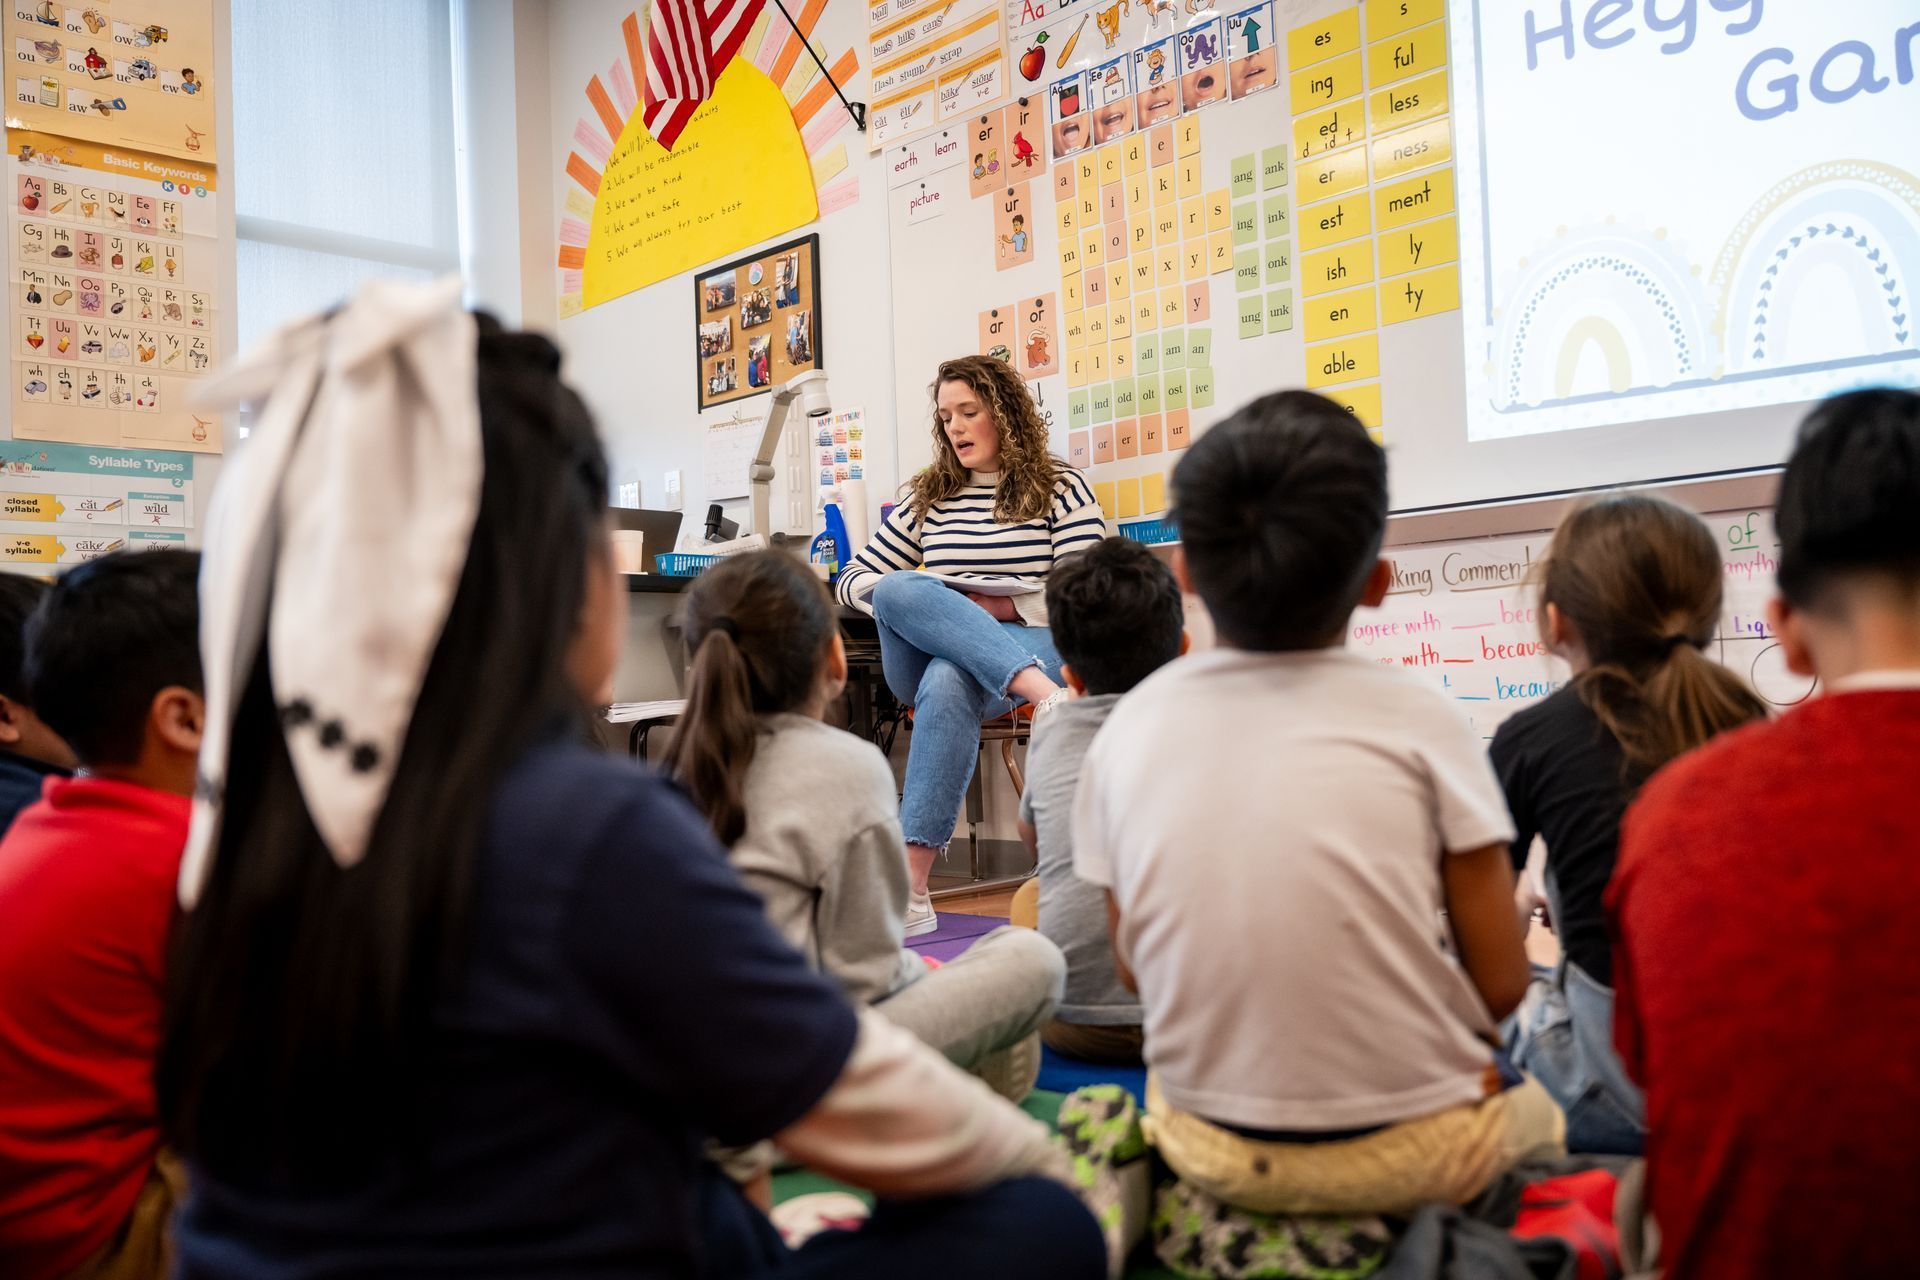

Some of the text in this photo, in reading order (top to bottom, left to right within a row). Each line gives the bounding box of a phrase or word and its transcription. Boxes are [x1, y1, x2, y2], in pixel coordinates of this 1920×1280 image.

[1021, 0, 1045, 26] Aa
[1400, 2, 1408, 15] s
[17, 10, 33, 21] oa
[67, 23, 82, 33] oe
[922, 16, 943, 32] cans
[1229, 18, 1242, 30] Uu
[114, 35, 133, 46] ow
[1180, 35, 1194, 46] Oo
[1314, 32, 1331, 46] es
[18, 51, 35, 62] ou
[1136, 52, 1144, 64] Ii
[1394, 42, 1414, 69] ful
[69, 63, 85, 72] oo
[874, 76, 894, 93] flash
[900, 64, 925, 80] stump
[940, 46, 963, 62] scrap
[116, 72, 131, 83] ue
[1091, 71, 1103, 82] Ee
[162, 83, 179, 93] ew
[1311, 76, 1333, 99] ing
[18, 93, 35, 103] au
[1390, 93, 1420, 114] less
[69, 103, 87, 113] aw
[693, 105, 719, 123] adults
[1019, 112, 1030, 126] ir
[1319, 112, 1338, 136] ed
[979, 127, 993, 141] er
[610, 155, 620, 170] We
[622, 141, 636, 158] will
[935, 141, 957, 157] learn
[1394, 140, 1429, 161] ness
[103, 153, 140, 171] Basic
[143, 164, 207, 183] Keywords
[614, 141, 700, 186] We will be responsible
[895, 152, 918, 172] earth
[1264, 161, 1284, 176] ank
[1234, 169, 1253, 185] ang
[1319, 170, 1335, 184] er
[24, 177, 40, 191] Aa
[53, 183, 67, 195] Bb
[81, 188, 96, 201] Cc
[108, 192, 124, 205] Dd
[615, 196, 626, 210] We
[629, 189, 642, 204] will
[647, 185, 657, 196] be
[1389, 180, 1431, 213] ment
[136, 197, 150, 210] Ee
[163, 202, 175, 214] Ff
[910, 191, 940, 215] picture
[1005, 198, 1019, 213] ur
[614, 199, 681, 234] We will be safe
[1268, 209, 1285, 224] ink
[1320, 205, 1344, 230] est
[616, 244, 629, 258] We
[633, 237, 644, 249] will
[646, 227, 672, 243] always
[677, 220, 691, 232] try
[721, 201, 742, 217] best
[1159, 220, 1172, 233] qu
[1237, 217, 1253, 232] ing
[23, 224, 43, 241] Gg
[54, 229, 70, 241] Hh
[84, 233, 96, 245] Ii
[111, 237, 123, 253] Jj
[137, 242, 151, 254] Kk
[1410, 233, 1423, 264] ly
[166, 246, 175, 258] Ll
[1268, 256, 1287, 269] onk
[1327, 257, 1346, 281] ish
[23, 271, 45, 284] Mm
[1238, 264, 1257, 279] ong
[54, 275, 71, 288] Nn
[81, 279, 100, 292] Oo
[111, 283, 125, 297] Pp
[138, 287, 153, 297] Qu
[165, 290, 177, 302] Rr
[141, 296, 151, 304] qu
[191, 294, 203, 305] Ss
[1405, 282, 1423, 312] ty
[1140, 307, 1150, 319] th
[1166, 301, 1177, 313] ck
[1270, 304, 1289, 318] unk
[1030, 309, 1045, 323] or
[1114, 314, 1125, 325] sh
[1241, 310, 1261, 325] ung
[1330, 308, 1349, 321] en
[27, 318, 41, 329] Tt
[56, 321, 70, 334] Uu
[84, 324, 99, 336] Vv
[990, 321, 1004, 334] ar
[1091, 320, 1102, 332] ch
[109, 327, 130, 340] Ww
[138, 331, 153, 343] Xx
[1068, 325, 1081, 336] wh
[166, 334, 180, 349] Yy
[192, 337, 205, 349] Zz
[1141, 349, 1153, 360] all
[1166, 345, 1181, 355] am
[1192, 344, 1204, 354] an
[1323, 351, 1355, 375] able
[28, 366, 43, 377] wh
[58, 369, 70, 379] ch
[87, 371, 98, 382] sh
[114, 373, 126, 385] th
[141, 377, 153, 388] ck
[1168, 384, 1183, 396] ost
[1195, 382, 1209, 394] ive
[1117, 392, 1132, 404] old
[1142, 389, 1154, 401] olt
[1073, 403, 1084, 415] ild
[1094, 398, 1109, 410] ind
[836, 411, 861, 424] BIRTHDAY
[1147, 429, 1155, 440] ir
[1172, 423, 1184, 436] ur
[1098, 439, 1107, 450] or
[1121, 434, 1131, 445] er
[1074, 446, 1084, 456] ar
[89, 455, 184, 473] Syllable Types
[7, 497, 38, 506] closed
[4, 505, 41, 515] syllable
[5, 546, 42, 556] syllable
[816, 539, 835, 550] EXPO
[1354, 623, 1399, 645] agree
[1405, 611, 1441, 634] with
[1402, 636, 1549, 667] with becaus
